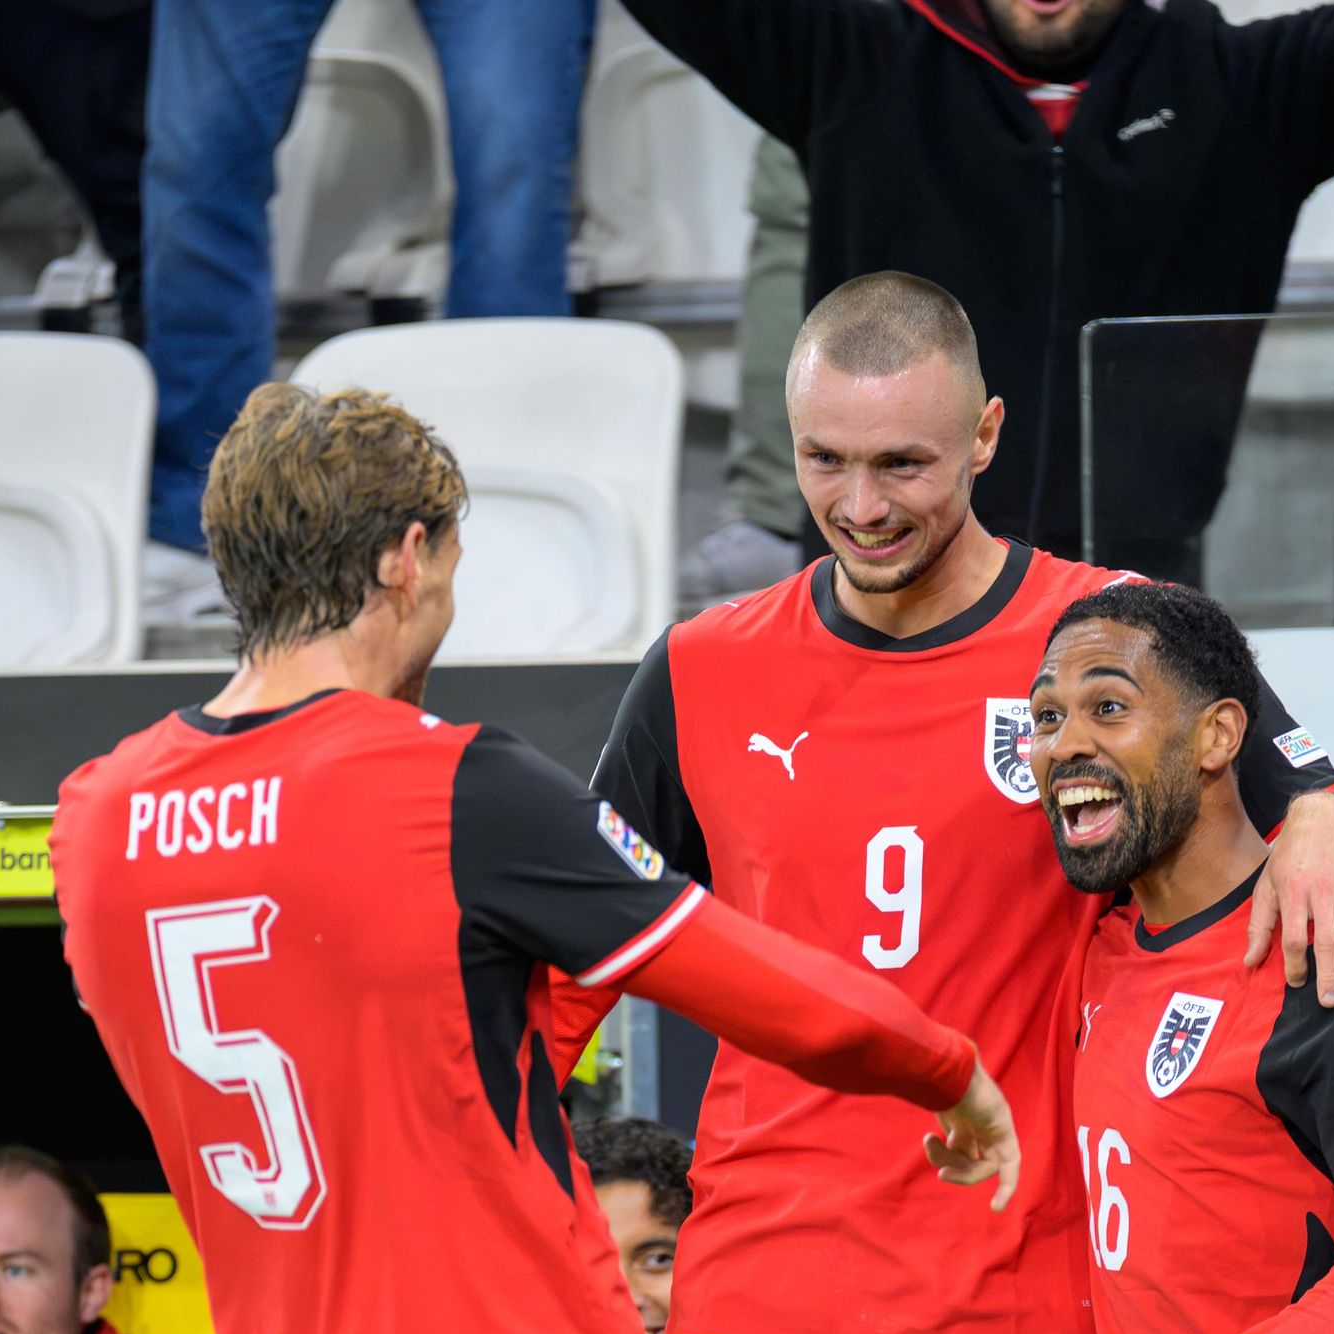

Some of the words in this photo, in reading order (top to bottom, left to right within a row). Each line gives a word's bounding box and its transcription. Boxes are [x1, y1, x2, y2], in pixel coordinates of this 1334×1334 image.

[125, 776, 282, 861] POSCH
[862, 825, 924, 970] 9
[1182, 1002, 1205, 1014] ÖFB
[145, 895, 328, 1231] 5
[114, 1248, 177, 1283] RO
